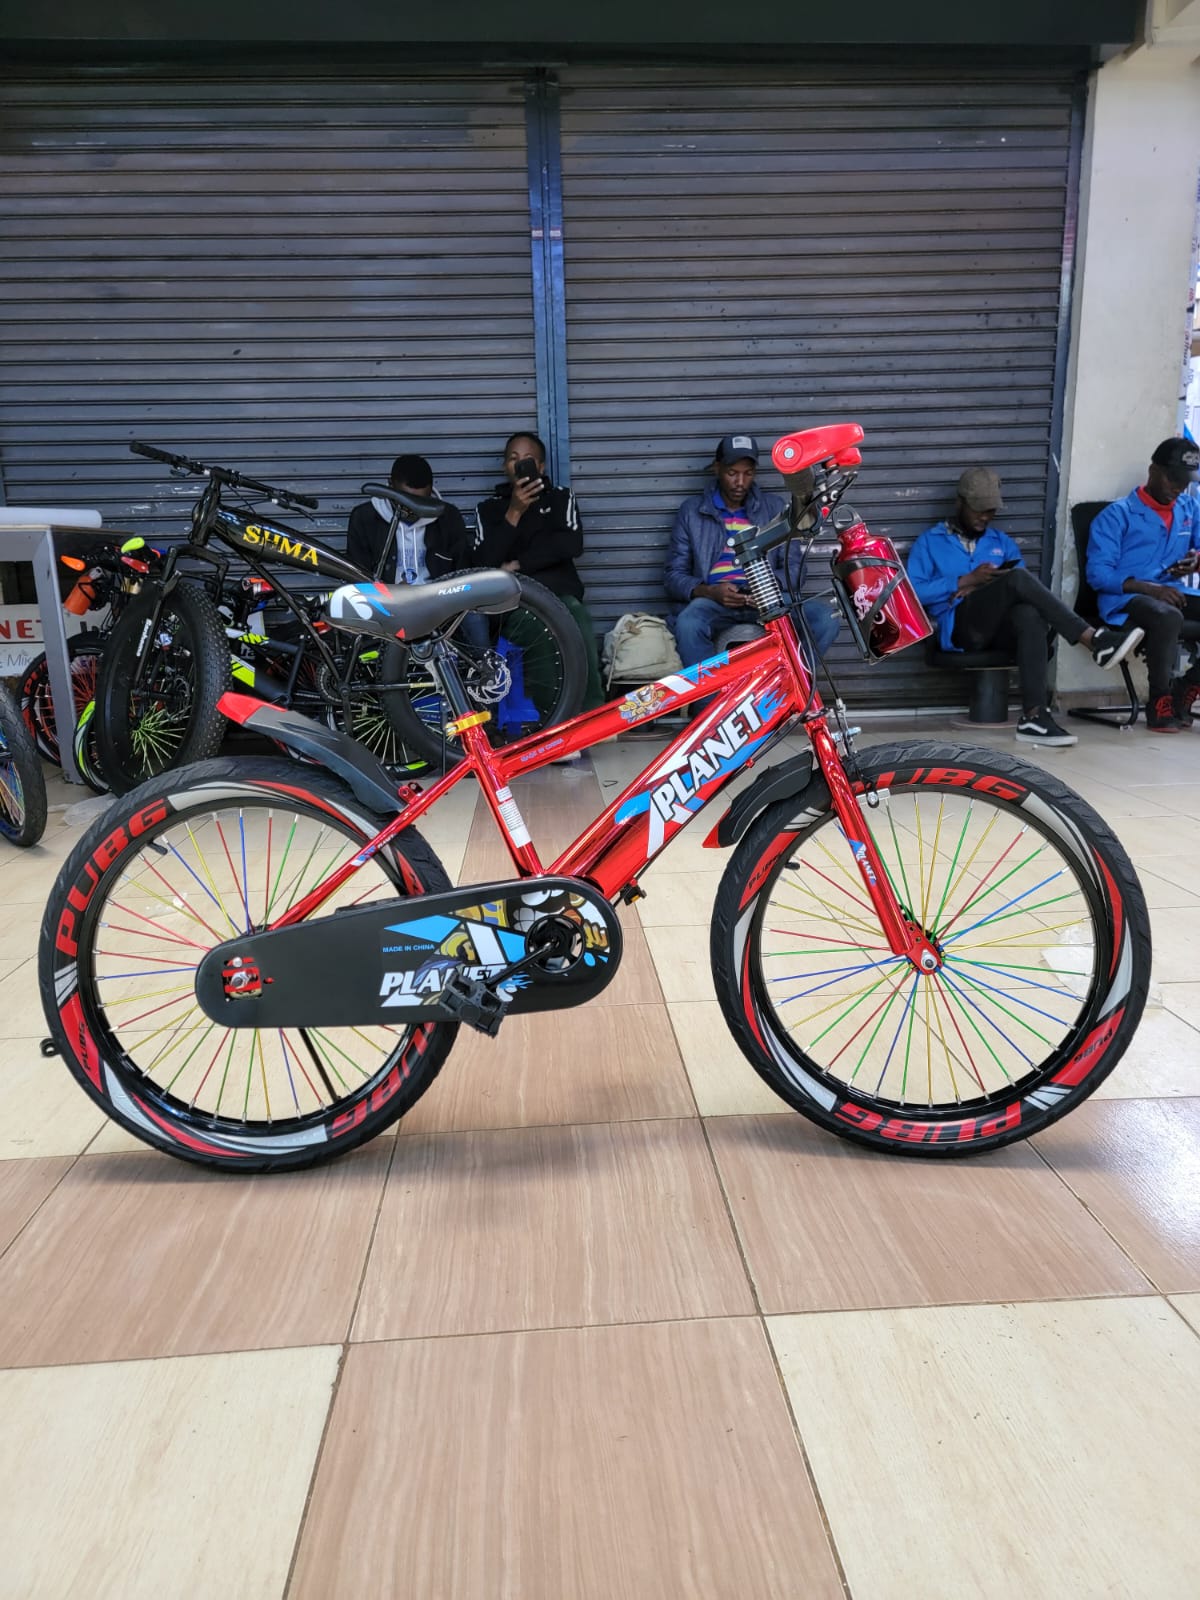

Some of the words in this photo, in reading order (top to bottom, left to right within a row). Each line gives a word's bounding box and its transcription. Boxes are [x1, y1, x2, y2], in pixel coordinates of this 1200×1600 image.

[0, 618, 42, 640] NE
[438, 584, 464, 597] PLANET
[651, 694, 763, 822] PLANET
[55, 798, 167, 958] PUBG
[331, 1021, 436, 1138] UBG
[834, 1100, 1022, 1144] PUBG
